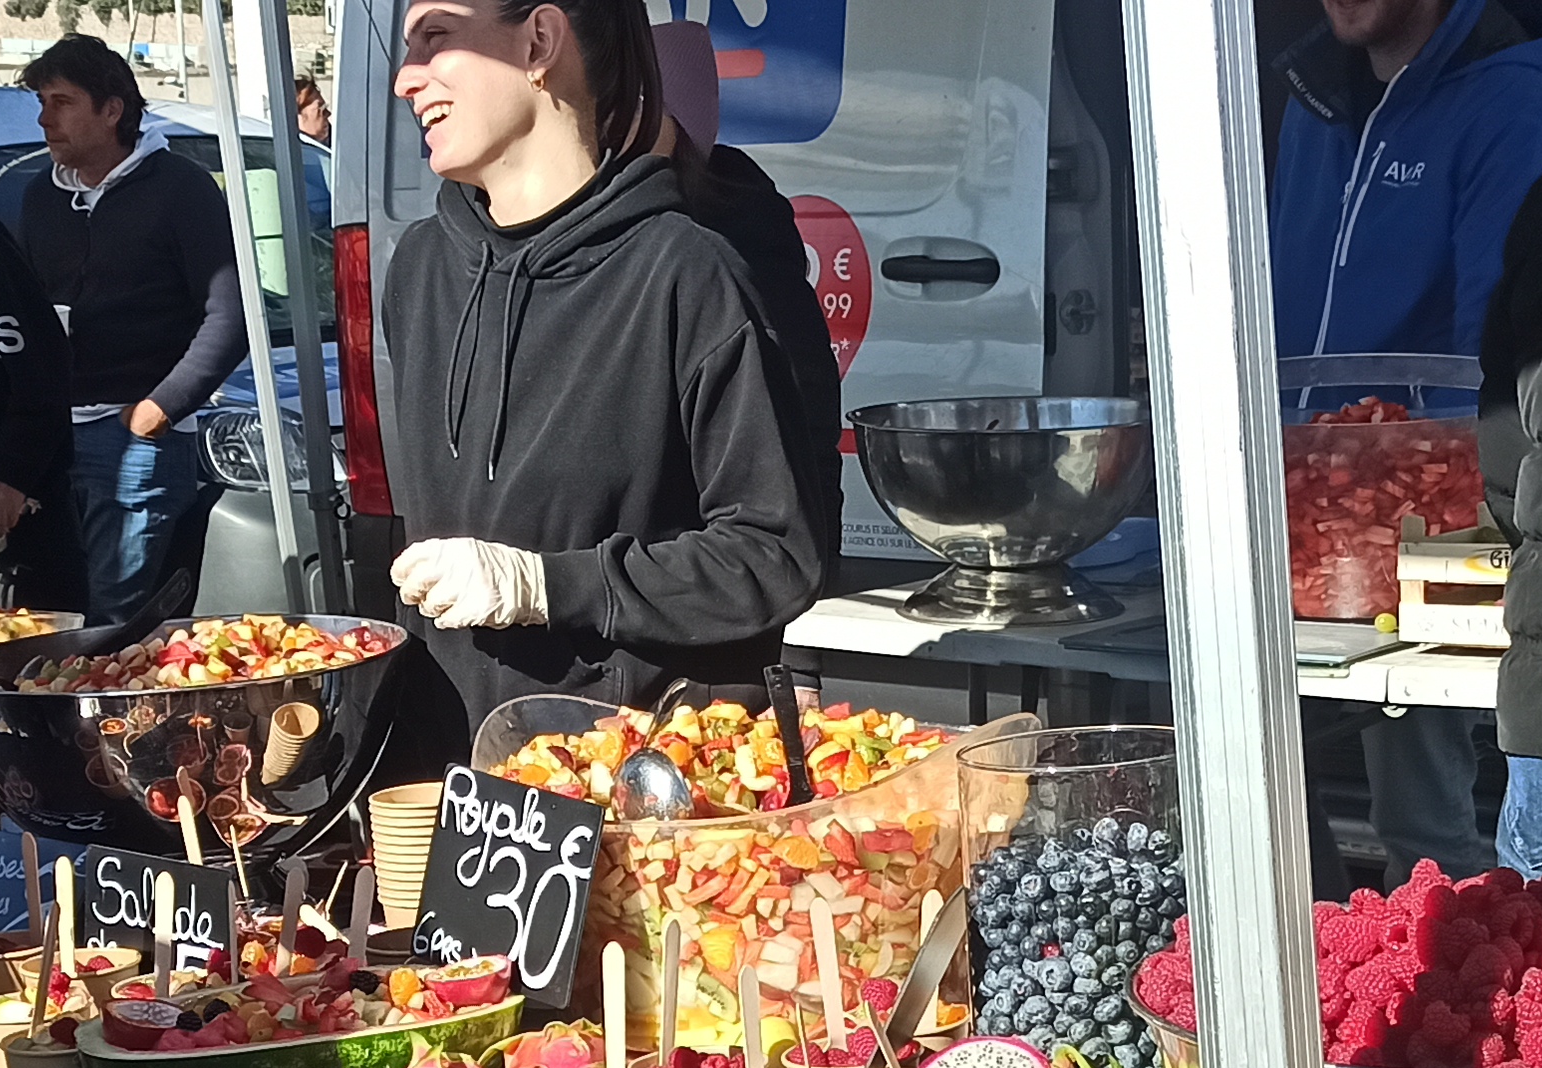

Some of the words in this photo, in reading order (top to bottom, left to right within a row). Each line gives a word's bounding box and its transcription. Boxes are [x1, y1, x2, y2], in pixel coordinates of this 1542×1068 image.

[1286, 68, 1307, 92] HELLY
[1305, 91, 1334, 119] HANSEN
[441, 766, 551, 887] Royale
[92, 857, 225, 951] Salde
[485, 846, 578, 990] 30
